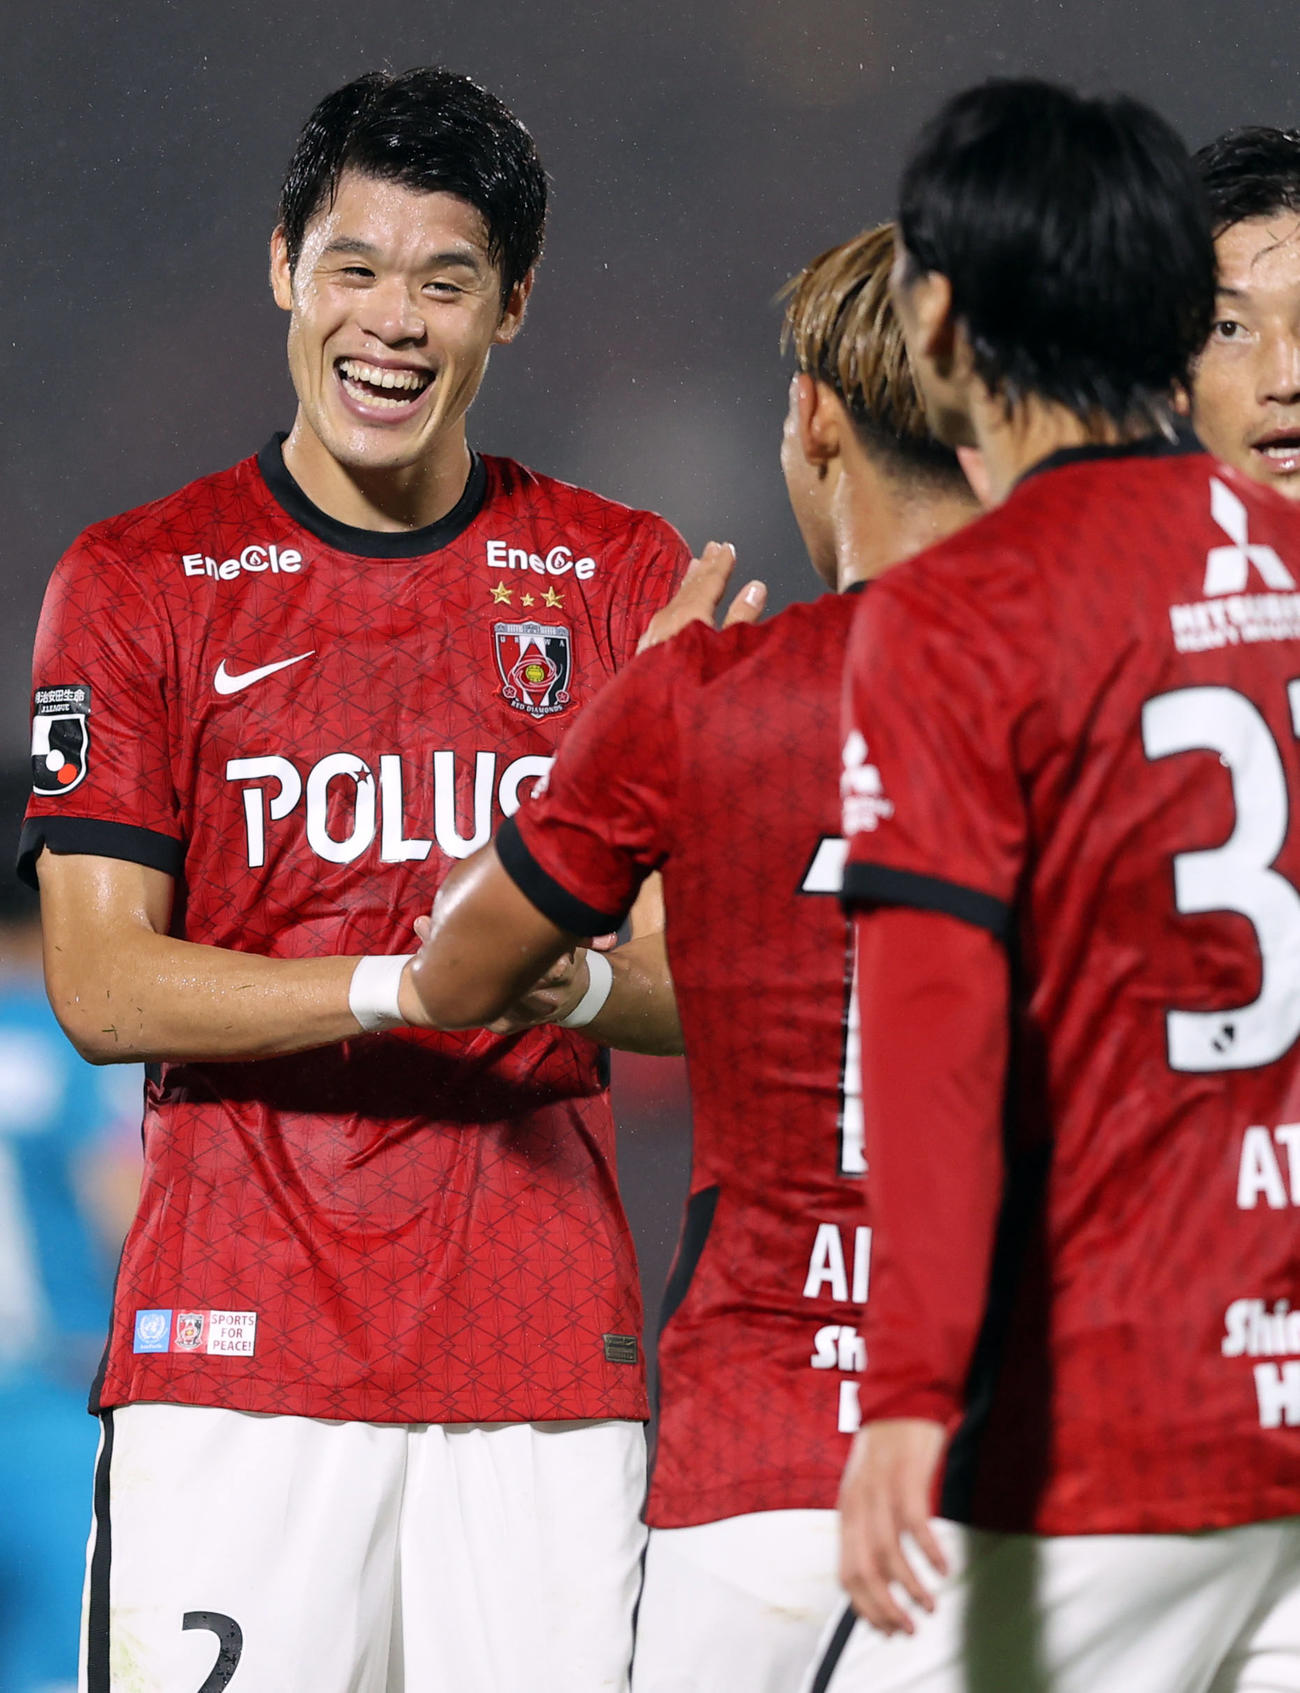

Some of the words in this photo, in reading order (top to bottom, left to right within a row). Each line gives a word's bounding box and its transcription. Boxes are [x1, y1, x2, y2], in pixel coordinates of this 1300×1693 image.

[182, 544, 302, 581] EneCle
[486, 540, 596, 580] EneCe
[511, 700, 525, 709] RED
[1142, 680, 1300, 1072] 3
[211, 1314, 255, 1325] SPORTS
[221, 1328, 243, 1338] FOR
[212, 1340, 252, 1351] PEACE!
[181, 1611, 243, 1693] 2
